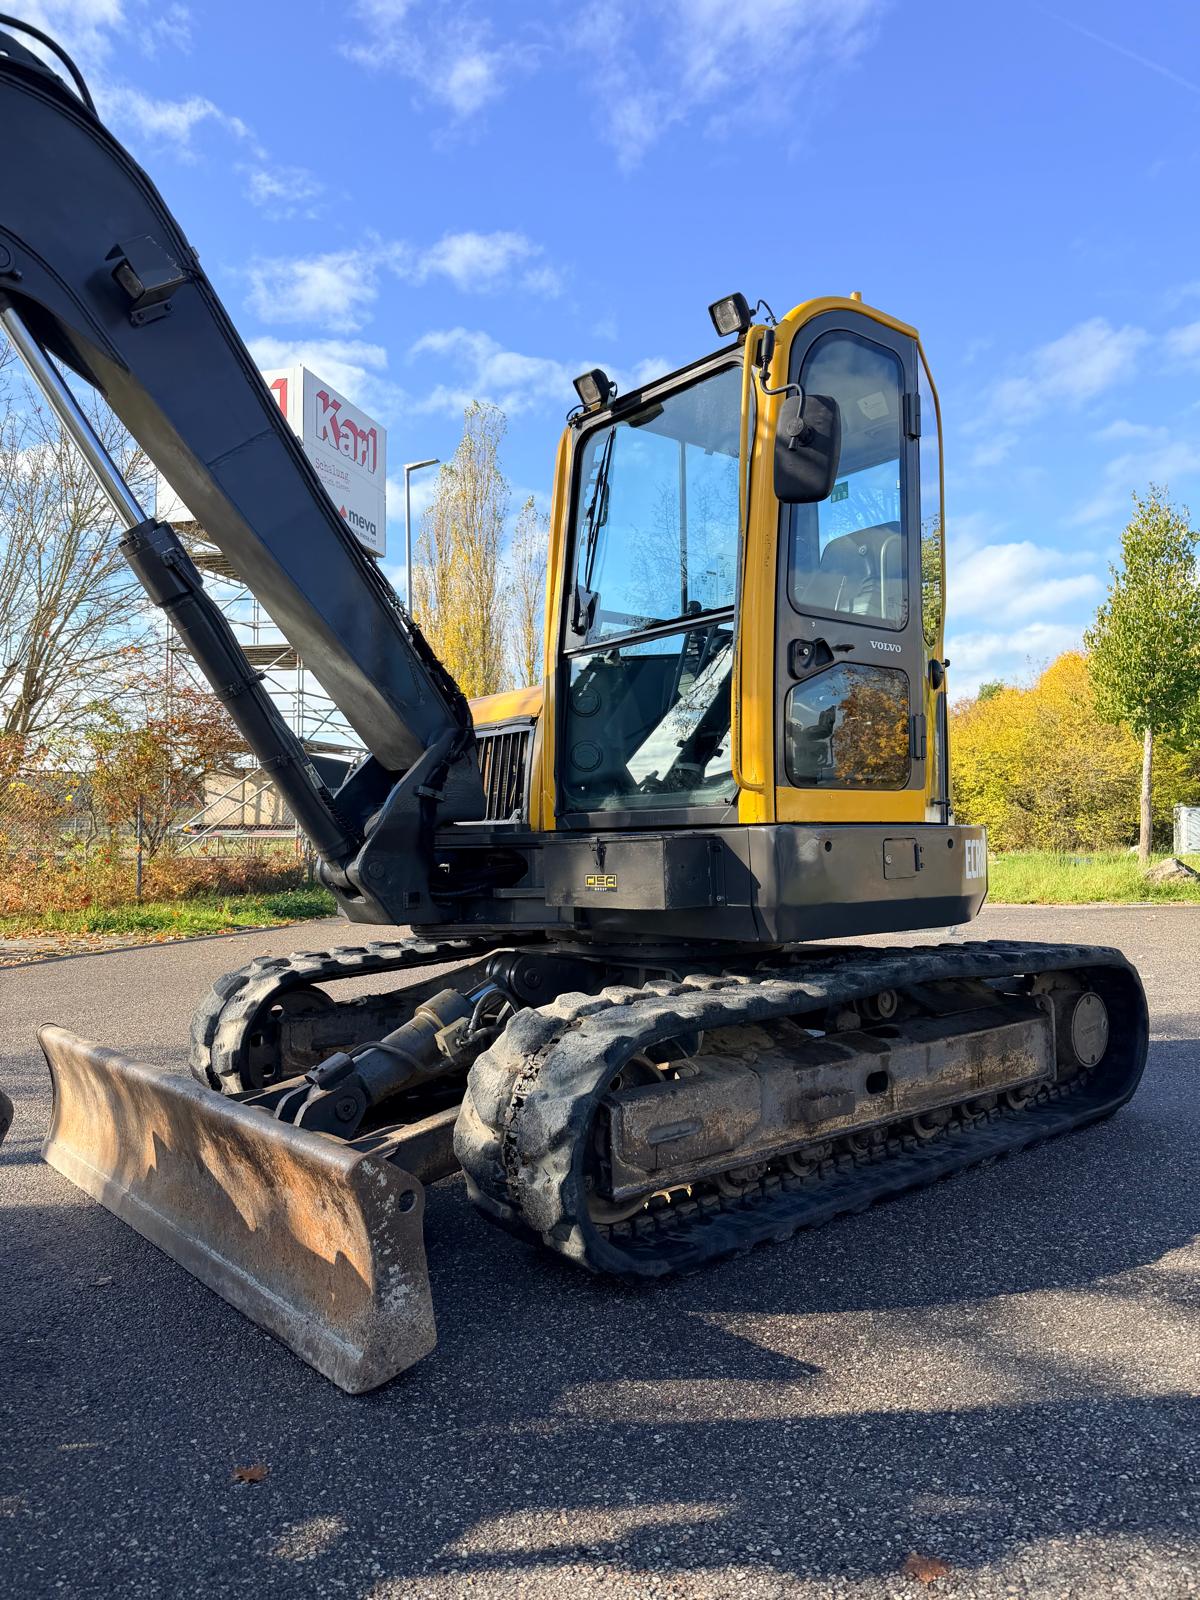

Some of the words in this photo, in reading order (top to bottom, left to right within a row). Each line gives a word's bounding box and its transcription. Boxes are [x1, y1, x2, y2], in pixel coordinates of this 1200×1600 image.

[316, 390, 377, 474] Karl
[348, 509, 377, 536] meva
[870, 640, 901, 653] VOLVO
